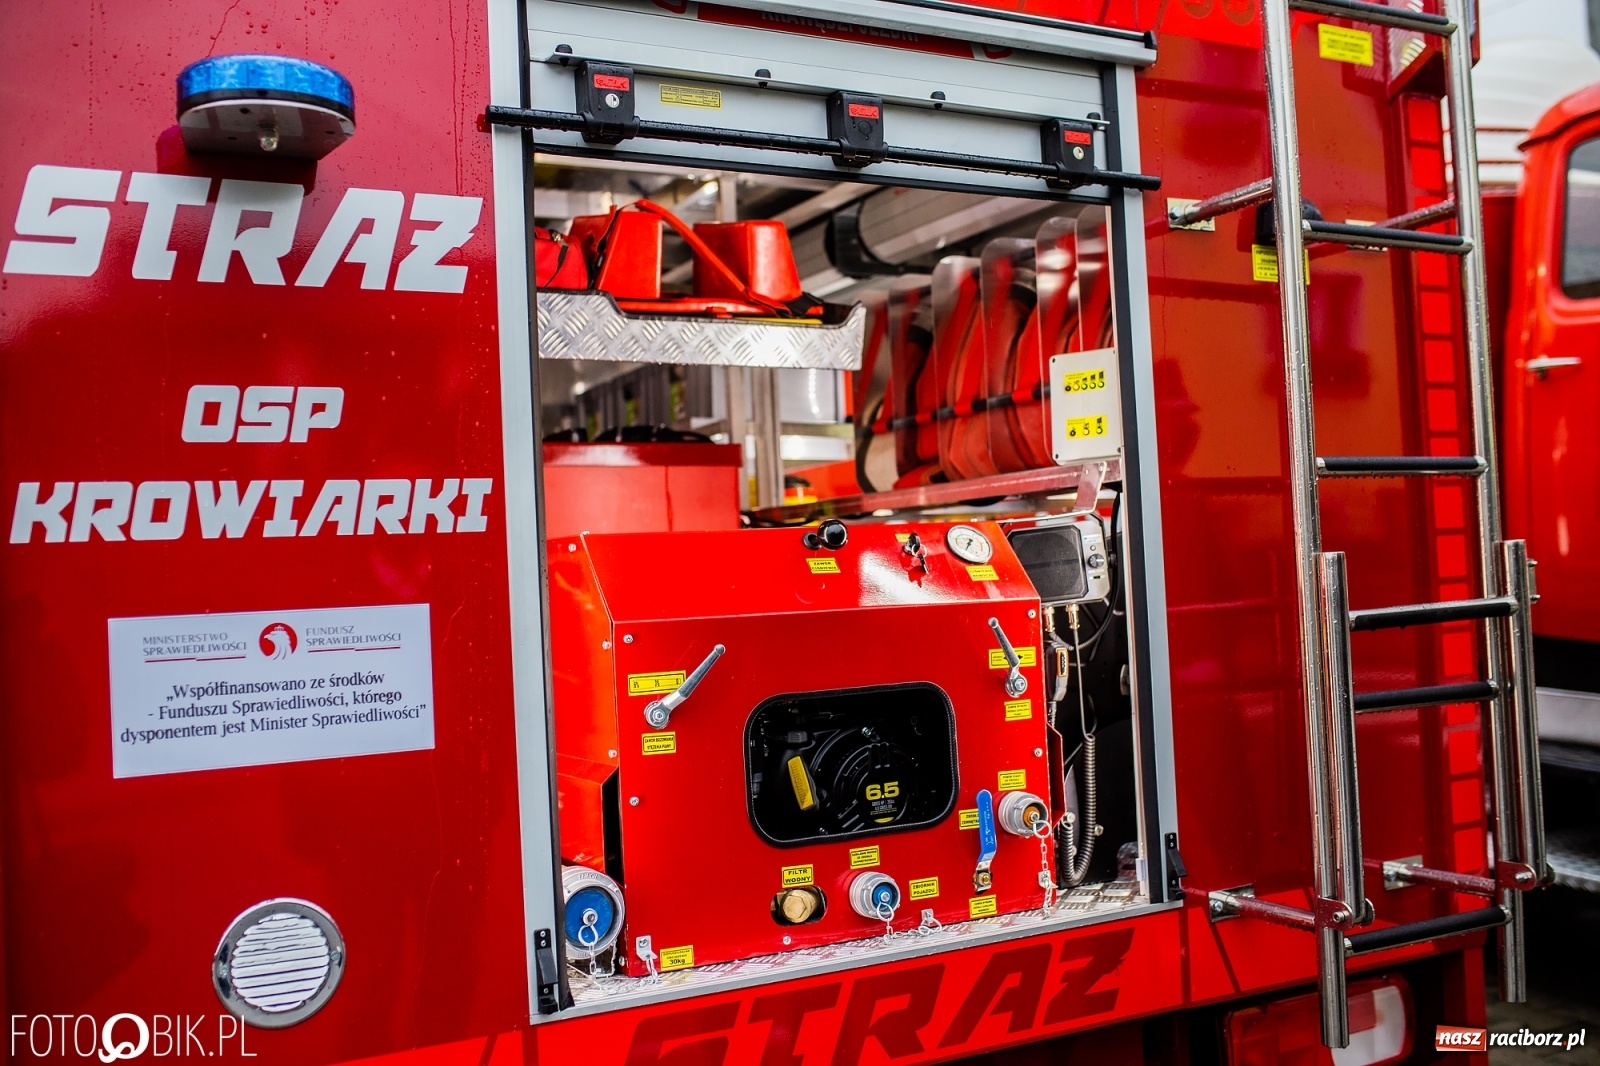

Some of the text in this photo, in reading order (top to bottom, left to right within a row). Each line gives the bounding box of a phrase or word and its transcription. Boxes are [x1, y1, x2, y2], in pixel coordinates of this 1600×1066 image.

[181, 384, 345, 443] OSP
[9, 477, 493, 544] KROWIARKI
[142, 632, 229, 645] MINISTERSTWO
[305, 625, 355, 636] FUNDUSZ
[305, 632, 402, 647] SPRAWIEDLIWOŚCI
[142, 641, 247, 657] SPRAWIEDLIWOŚCI
[310, 679, 325, 690] ze
[328, 672, 385, 688] środków
[158, 703, 228, 720] Funduszu
[232, 693, 349, 715] Sprawiedliwości,
[352, 689, 402, 707] którego
[120, 721, 217, 745] dysponentem
[219, 718, 247, 738] jest
[250, 715, 308, 733] Minister
[866, 781, 899, 800] 6.5
